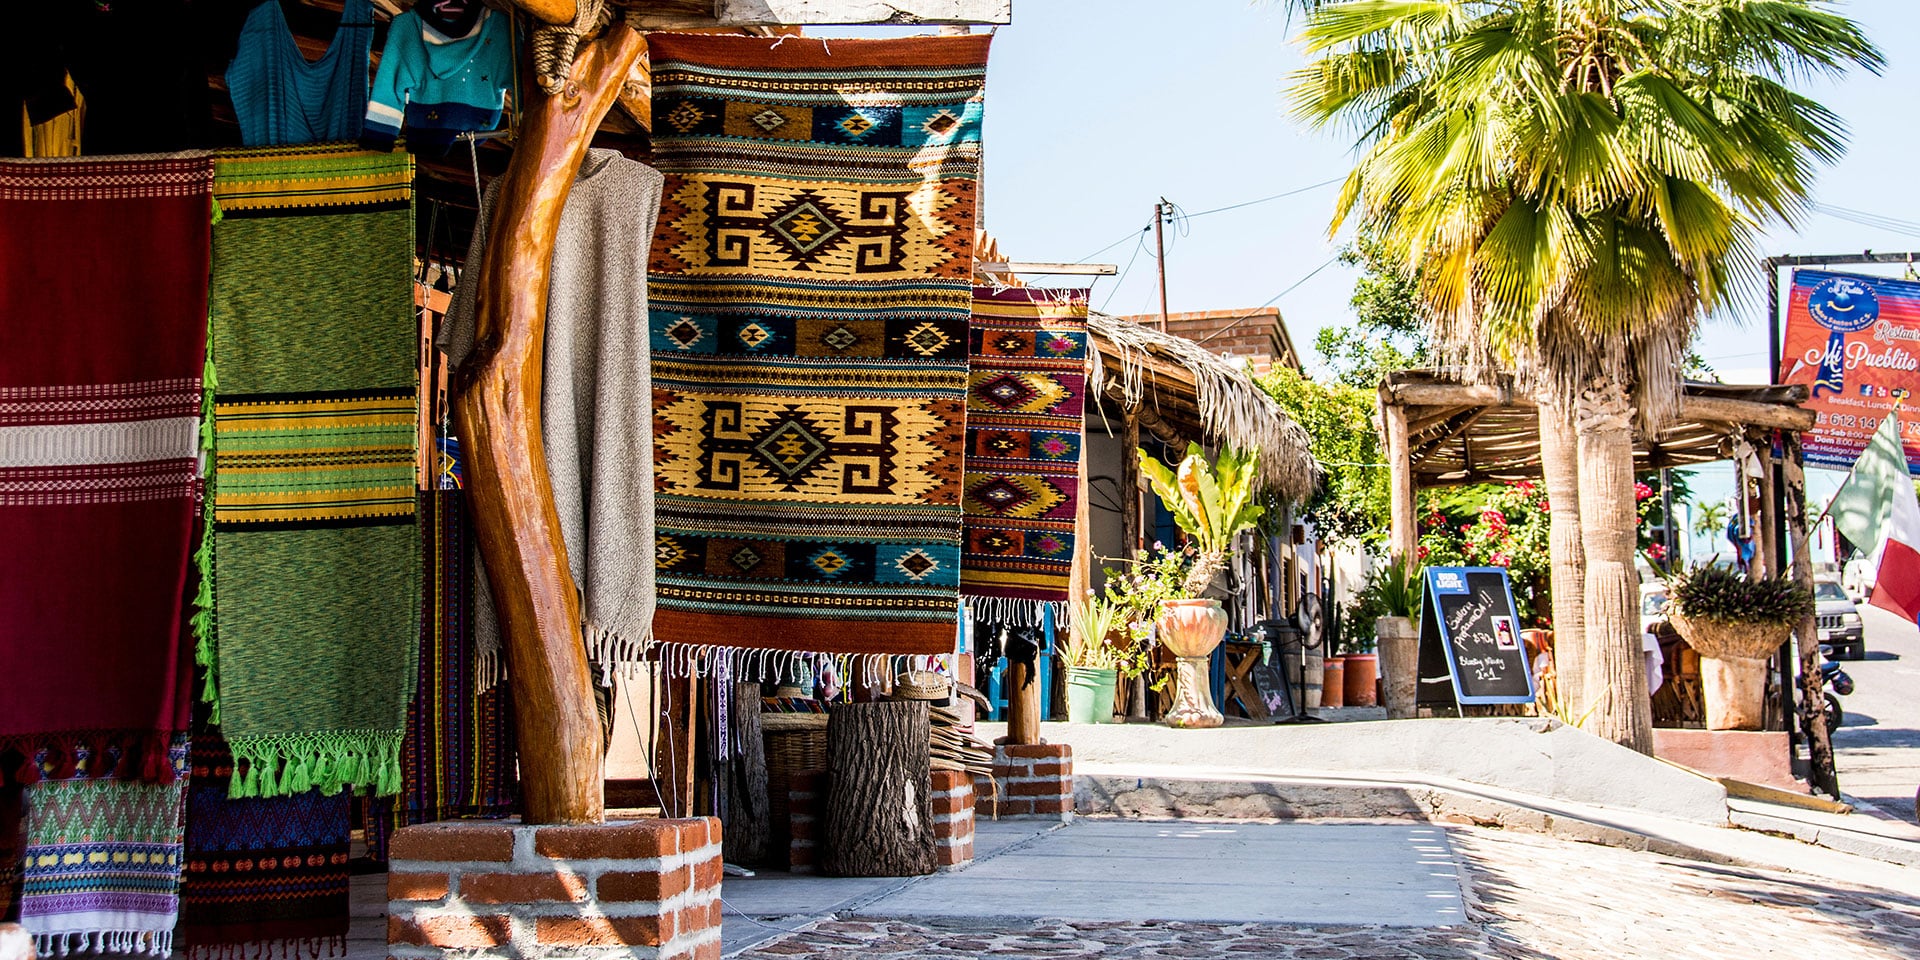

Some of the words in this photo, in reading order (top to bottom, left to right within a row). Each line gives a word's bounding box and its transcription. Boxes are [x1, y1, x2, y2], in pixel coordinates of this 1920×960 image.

[1805, 339, 1842, 367] Mi
[1845, 341, 1917, 371] Pueblito
[1828, 396, 1865, 408] Breakfast,
[1831, 413, 1855, 427] 612
[1860, 417, 1876, 429] 14
[1830, 428, 1846, 437] Sab
[1815, 437, 1835, 445] Dom
[1801, 443, 1819, 452] Calle
[1436, 581, 1463, 589] LIGHT
